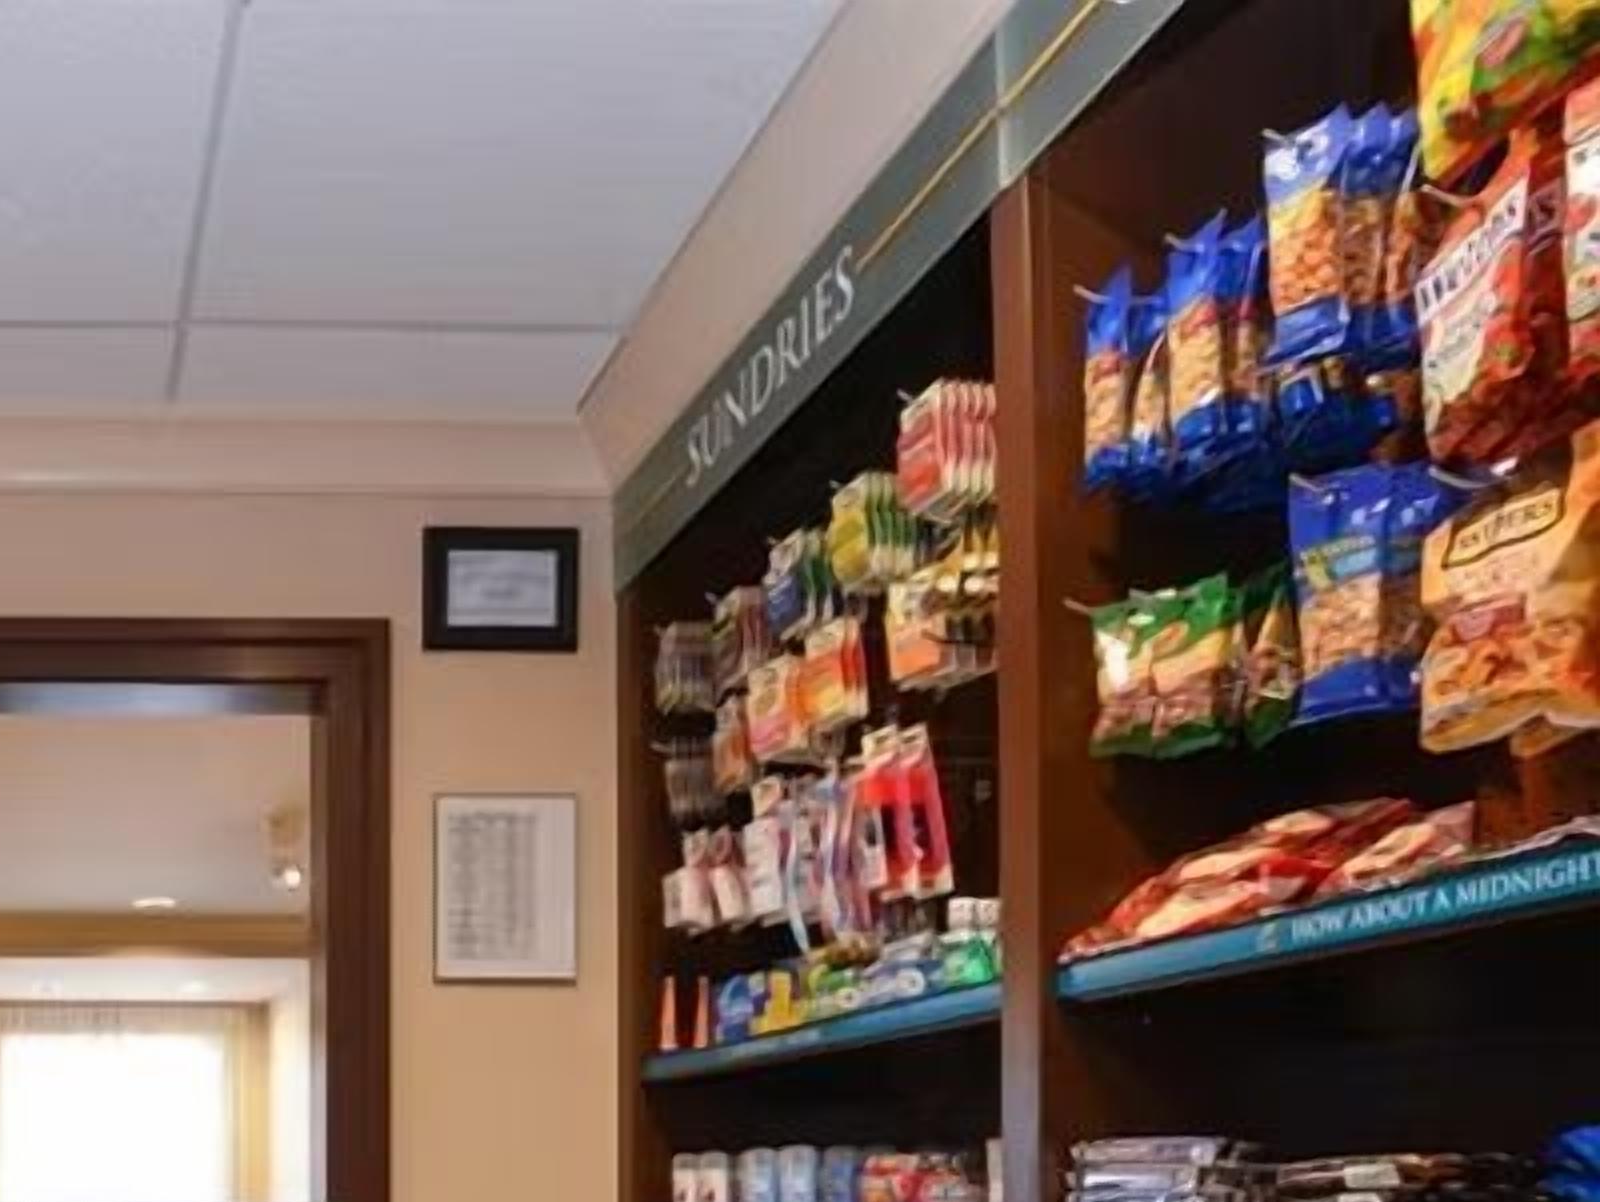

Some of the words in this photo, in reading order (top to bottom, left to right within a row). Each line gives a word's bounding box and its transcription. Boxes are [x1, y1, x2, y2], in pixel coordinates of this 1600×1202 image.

[686, 245, 854, 487] SUNDRIES
[1291, 912, 1342, 941] HOW
[1349, 889, 1427, 932] ABOUT
[1432, 888, 1451, 908] A
